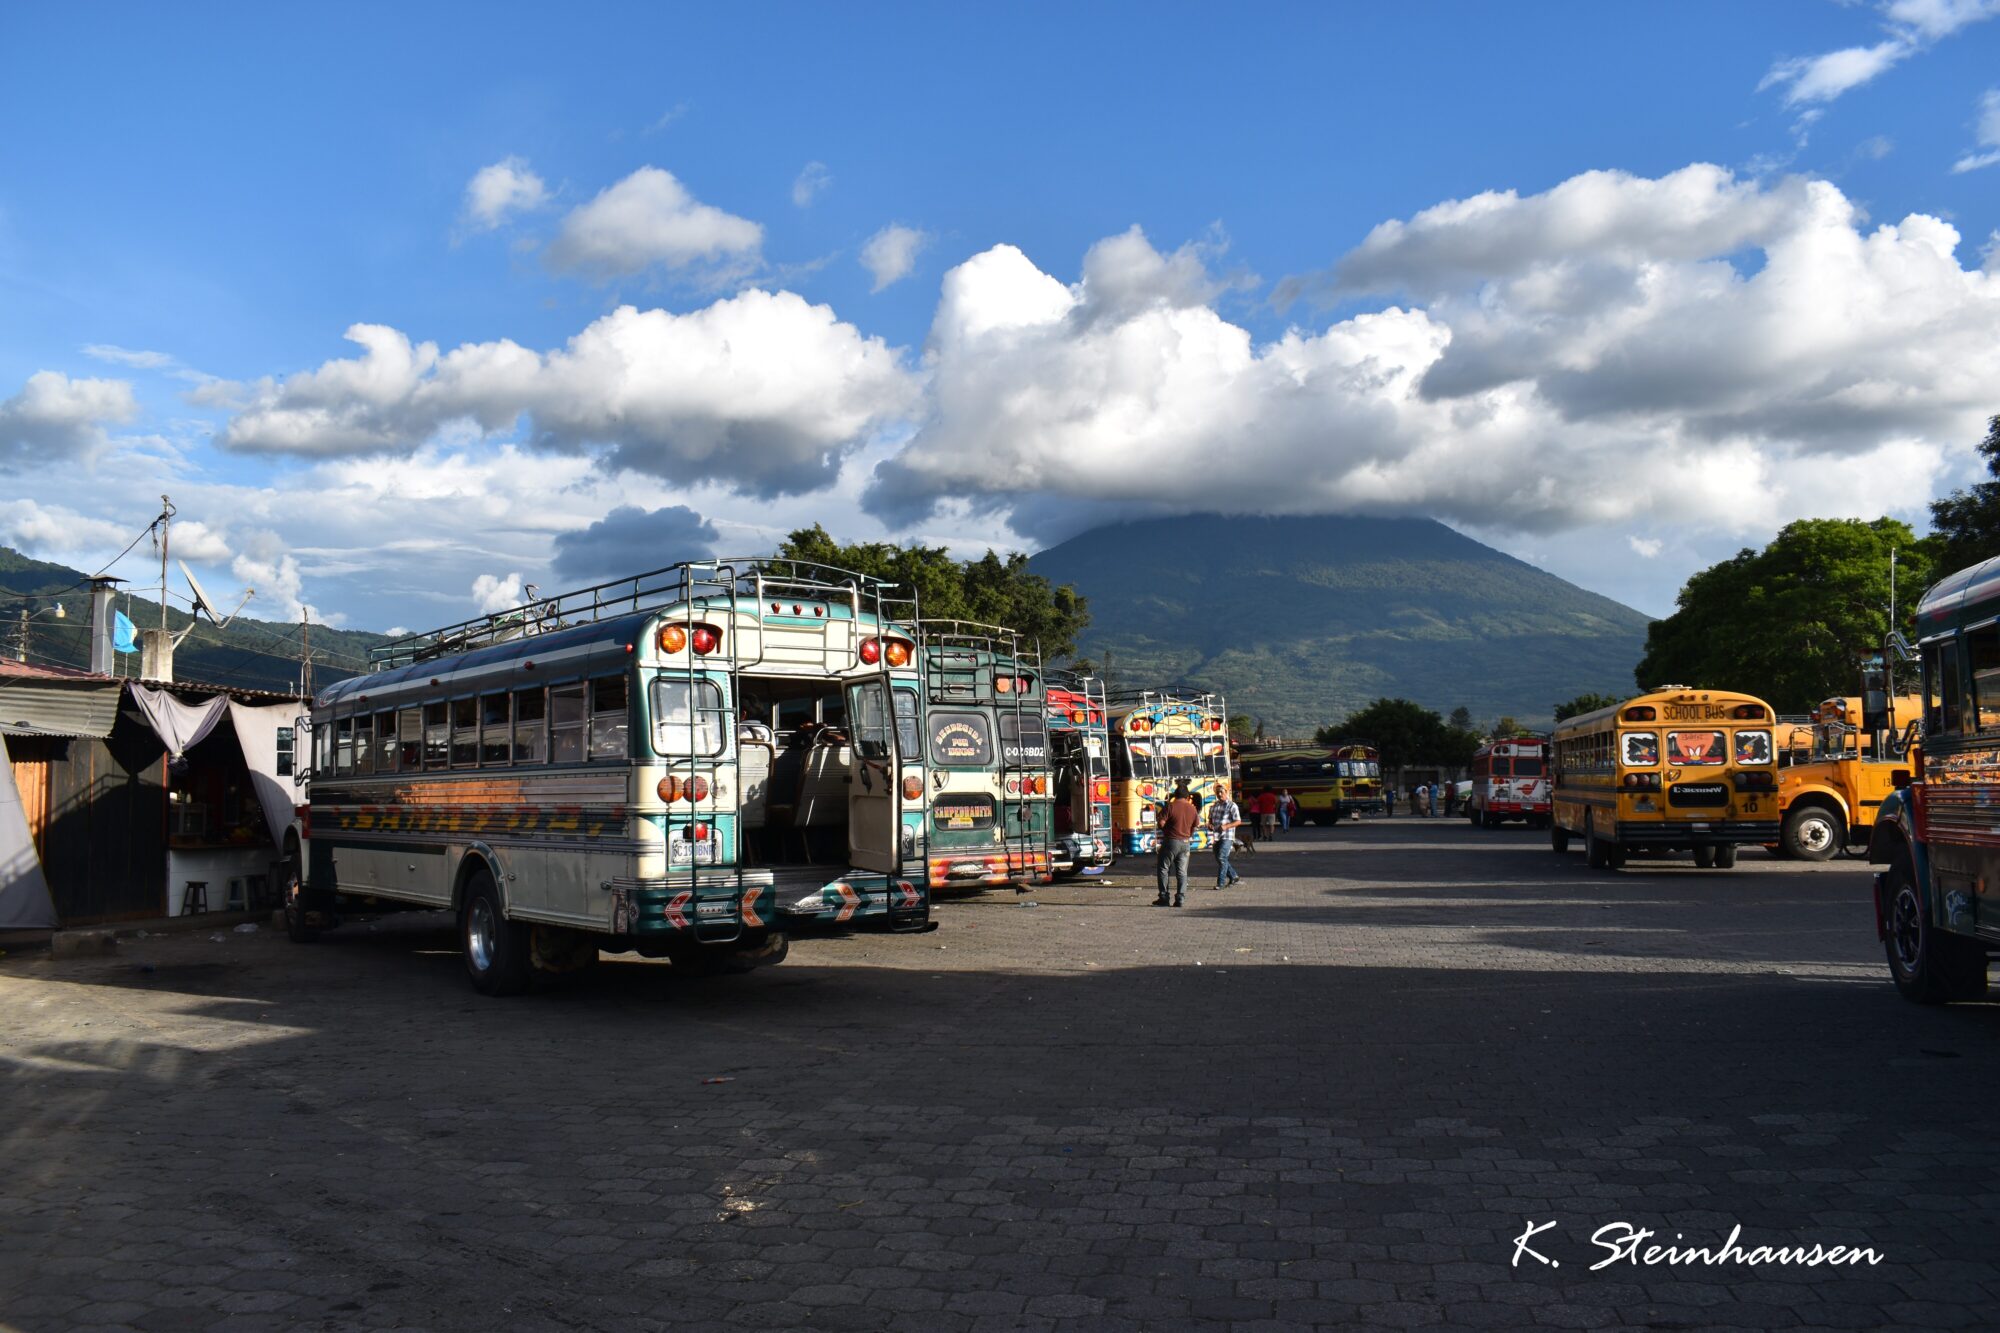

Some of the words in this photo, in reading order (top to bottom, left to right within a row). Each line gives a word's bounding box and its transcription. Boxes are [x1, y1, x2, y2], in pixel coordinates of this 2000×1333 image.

[1663, 705, 1701, 720] SCHOOL
[1704, 704, 1726, 720] BUS
[1742, 803, 1758, 812] 10
